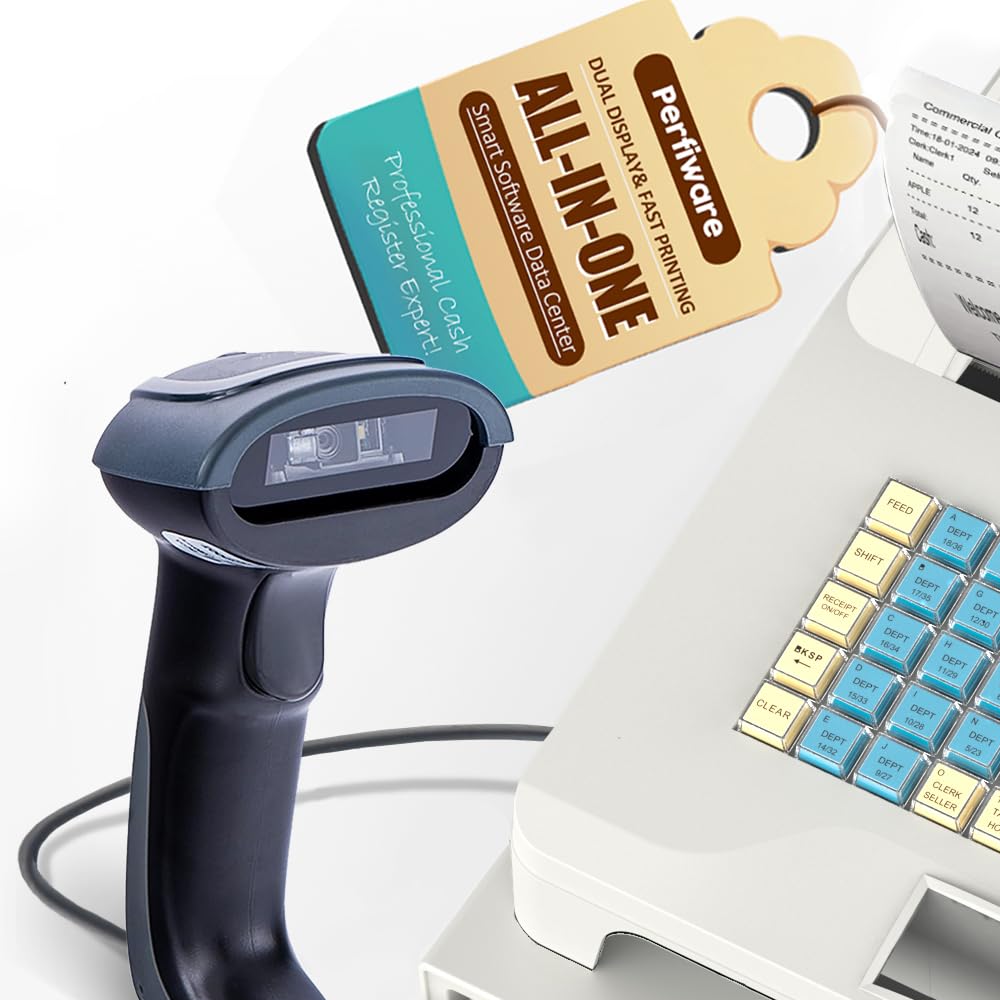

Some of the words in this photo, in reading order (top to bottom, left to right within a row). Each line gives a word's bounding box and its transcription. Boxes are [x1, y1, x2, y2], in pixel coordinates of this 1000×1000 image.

[923, 101, 993, 135] Commercial
[651, 85, 724, 239] Perfiware
[588, 56, 612, 104] DUAL
[636, 189, 665, 233] FAST
[653, 233, 696, 315] PRINTING
[513, 71, 659, 341] ALL-IN-ONE
[967, 205, 979, 216] 12
[472, 102, 503, 157] Smart
[492, 160, 534, 244] Software
[524, 244, 551, 290] Data
[540, 291, 577, 355] Center
[970, 231, 983, 242] 12
[384, 150, 451, 294] Professional
[438, 296, 474, 354] Cash
[362, 178, 409, 273] Register
[401, 277, 441, 357] Expert!
[887, 498, 914, 516] FEED
[947, 525, 973, 542] DEPT
[854, 547, 885, 567] SHIFT
[914, 576, 941, 593] DEPT
[823, 593, 858, 613] RECEIPT
[976, 590, 984, 599] G
[820, 603, 850, 620] ON/OFF
[887, 614, 895, 623] C
[973, 603, 999, 619] DEPT
[883, 627, 910, 644] DEPT
[794, 645, 824, 663] BKSP
[942, 653, 968, 670] DEPT
[855, 663, 863, 672] D
[852, 677, 879, 693] DEPT
[756, 699, 792, 720] CLEAR
[910, 704, 937, 720] DEPT
[820, 729, 847, 746] DEPT
[968, 730, 995, 747] DEPT
[877, 755, 904, 773] DEPT
[932, 781, 963, 800] CLERK
[923, 791, 958, 812] SELLER
